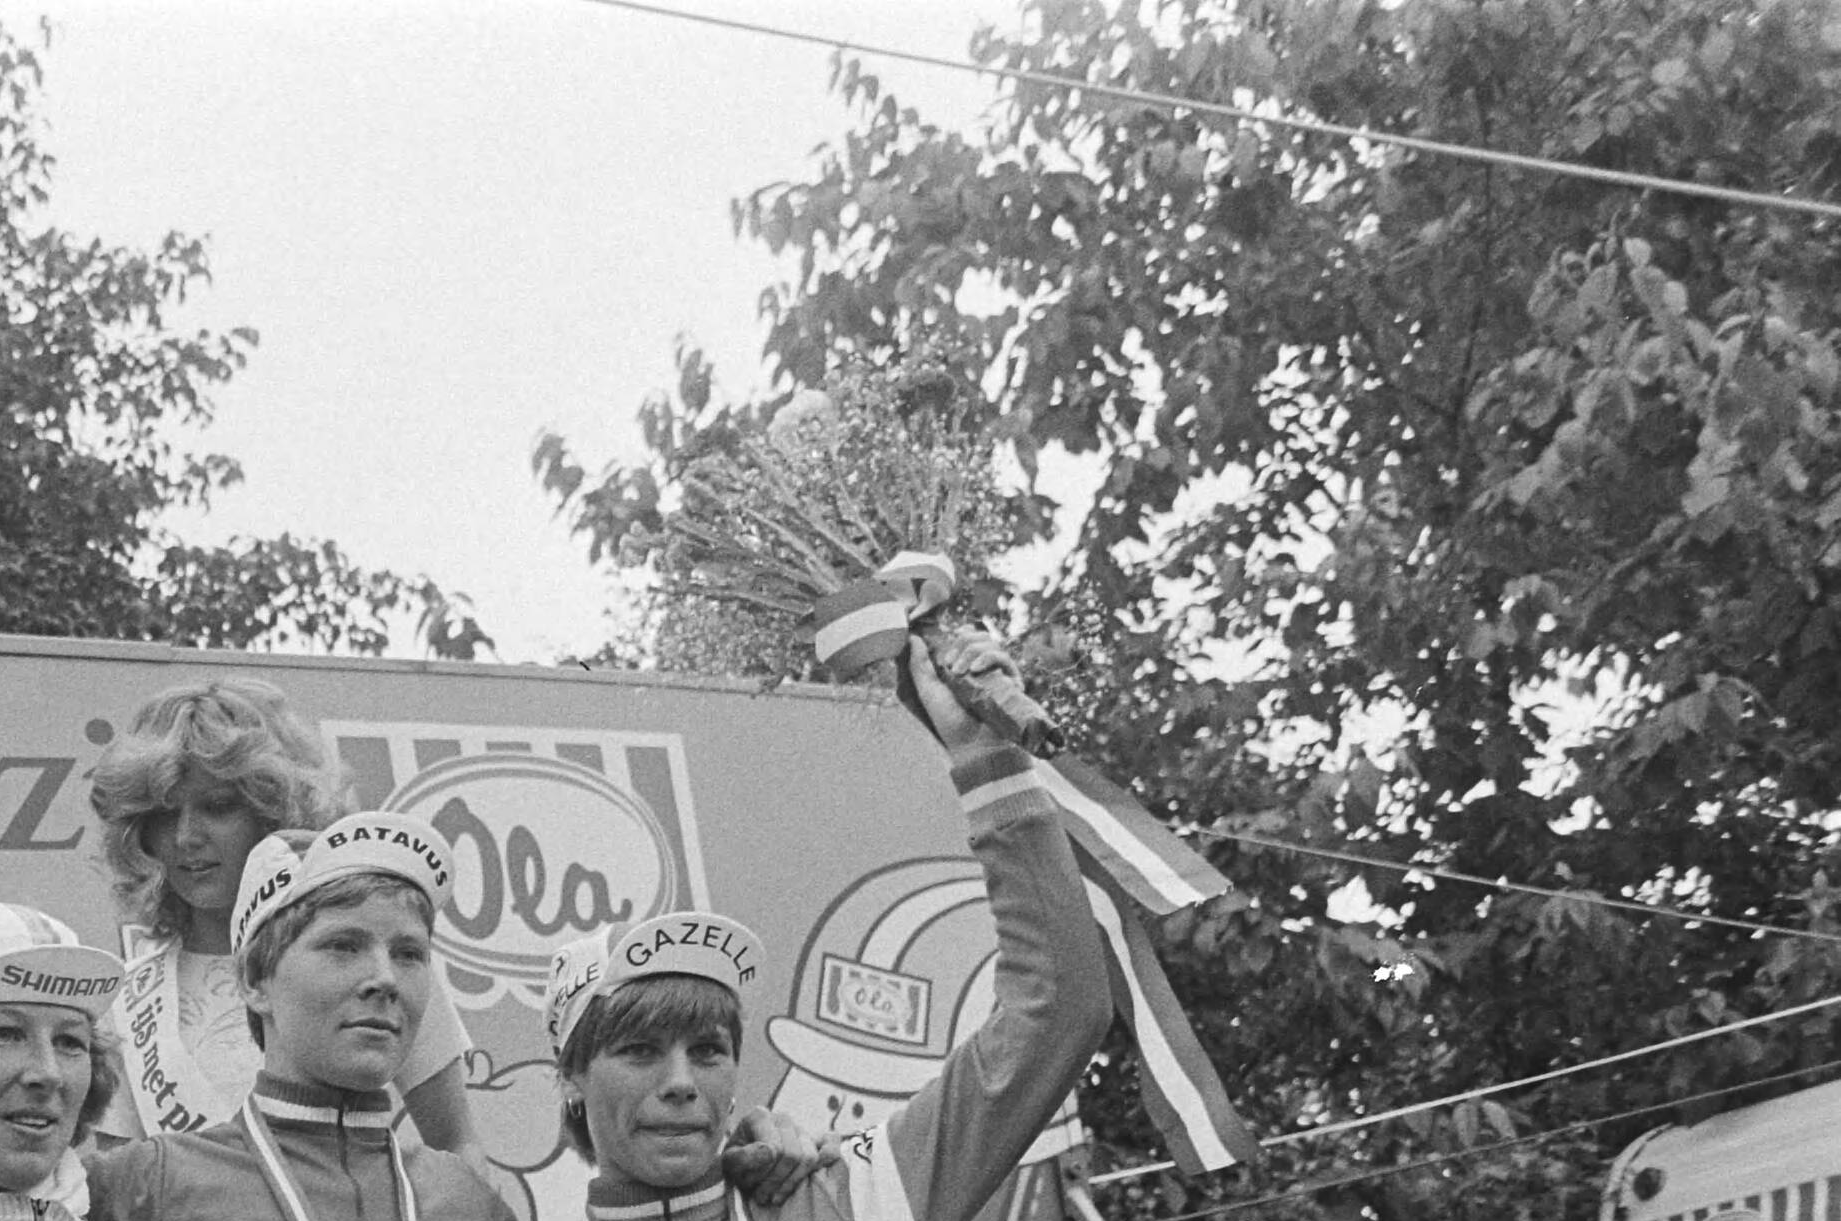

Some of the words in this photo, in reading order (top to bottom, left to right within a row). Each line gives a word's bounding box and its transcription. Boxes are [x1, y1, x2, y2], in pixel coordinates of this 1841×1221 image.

[327, 827, 448, 887] BATAVUS
[431, 797, 633, 940] Ola
[1, 965, 119, 997] SHIMANO
[626, 923, 755, 986] GAZELLE
[131, 996, 163, 1049] ijs
[142, 1042, 178, 1108] met
